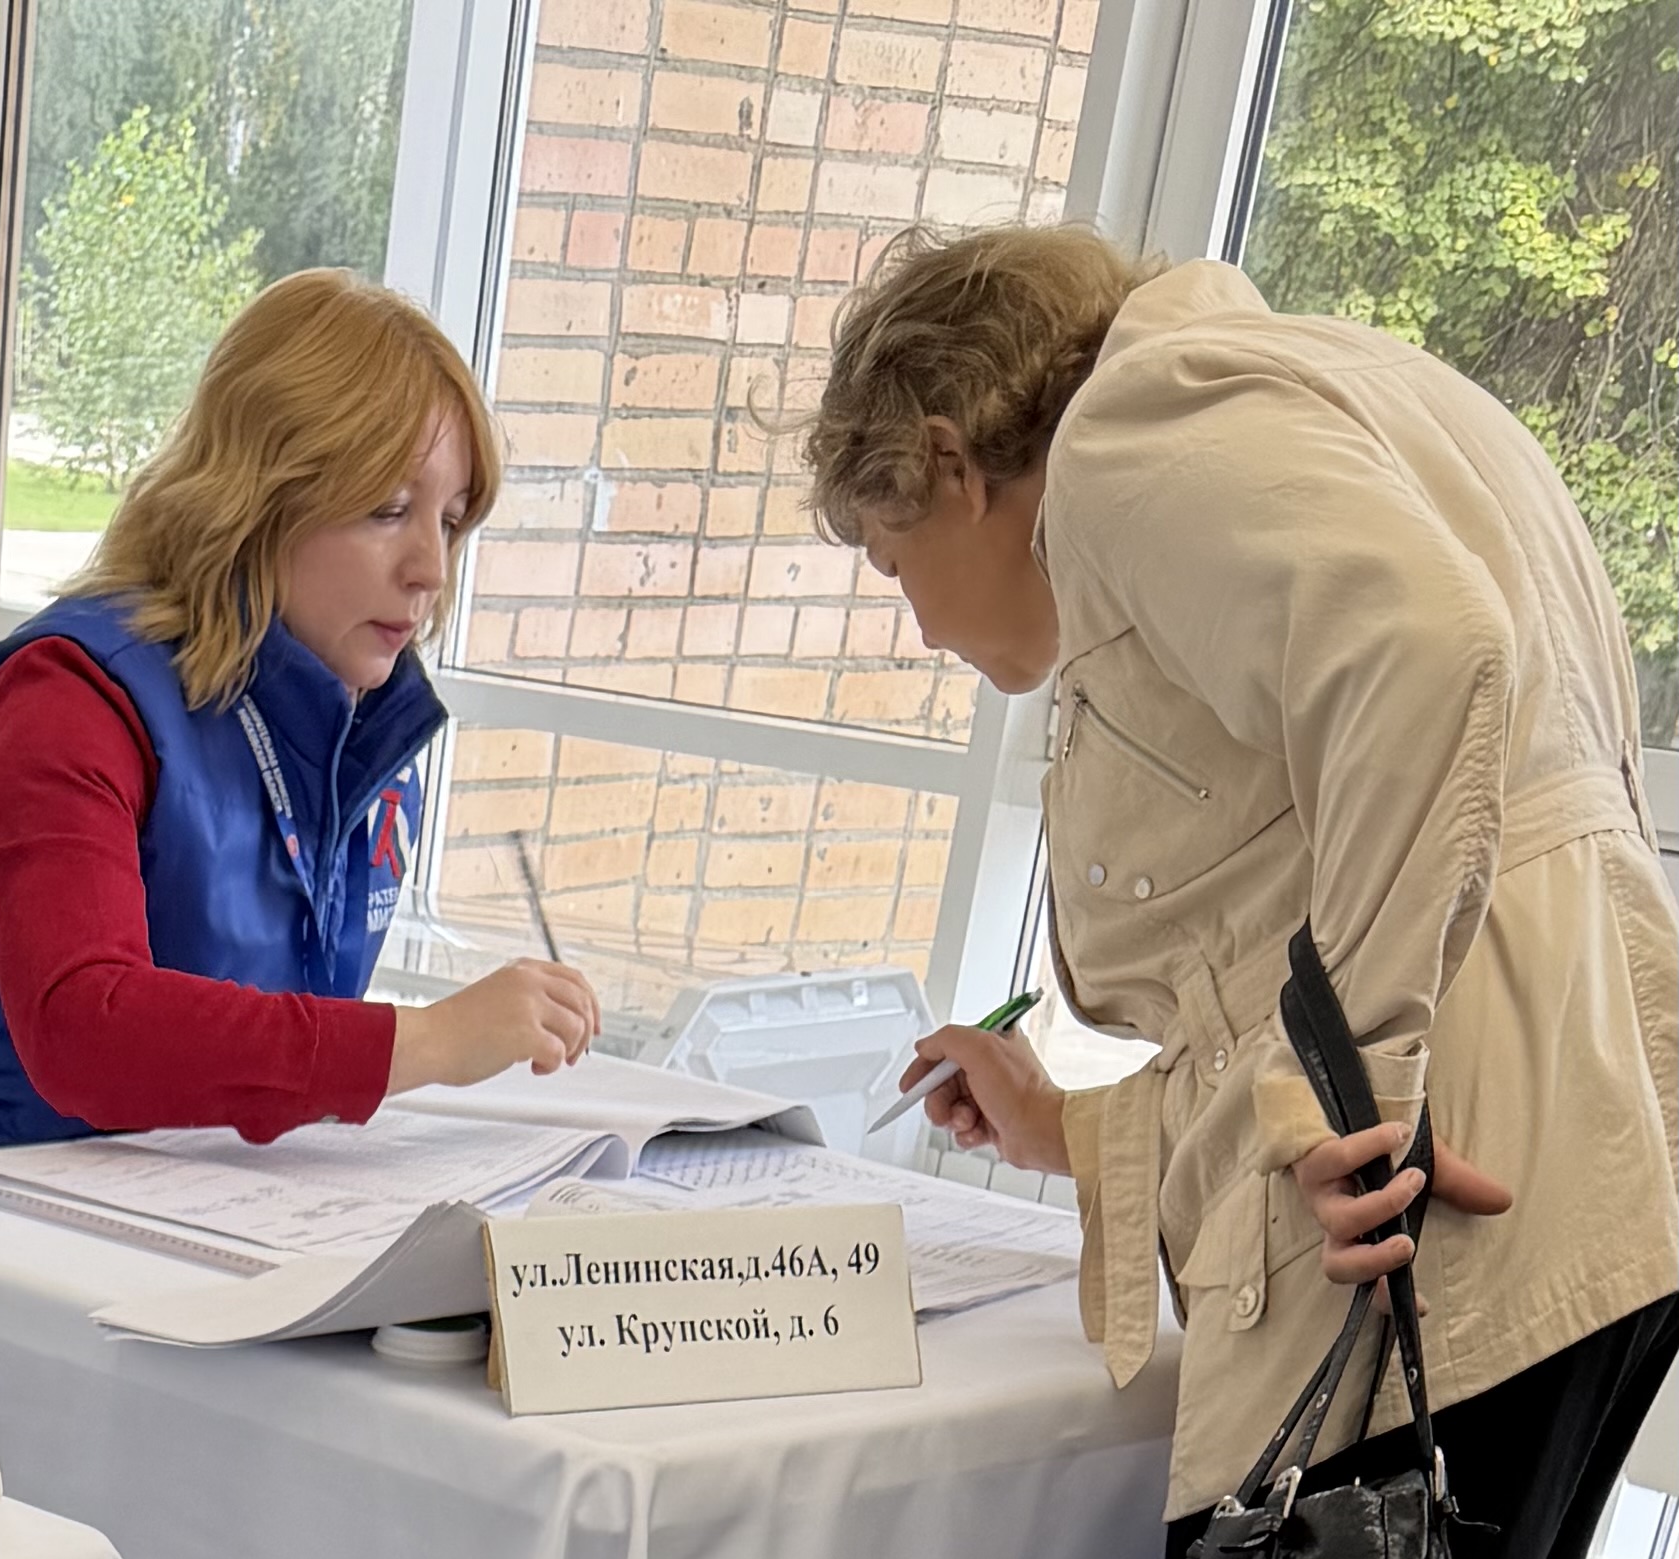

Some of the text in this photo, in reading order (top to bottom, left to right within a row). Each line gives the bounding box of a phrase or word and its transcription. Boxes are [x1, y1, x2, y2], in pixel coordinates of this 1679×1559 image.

[846, 1241, 881, 1276] 49
[556, 1303, 840, 1358] ул. Крупской, д. 6
